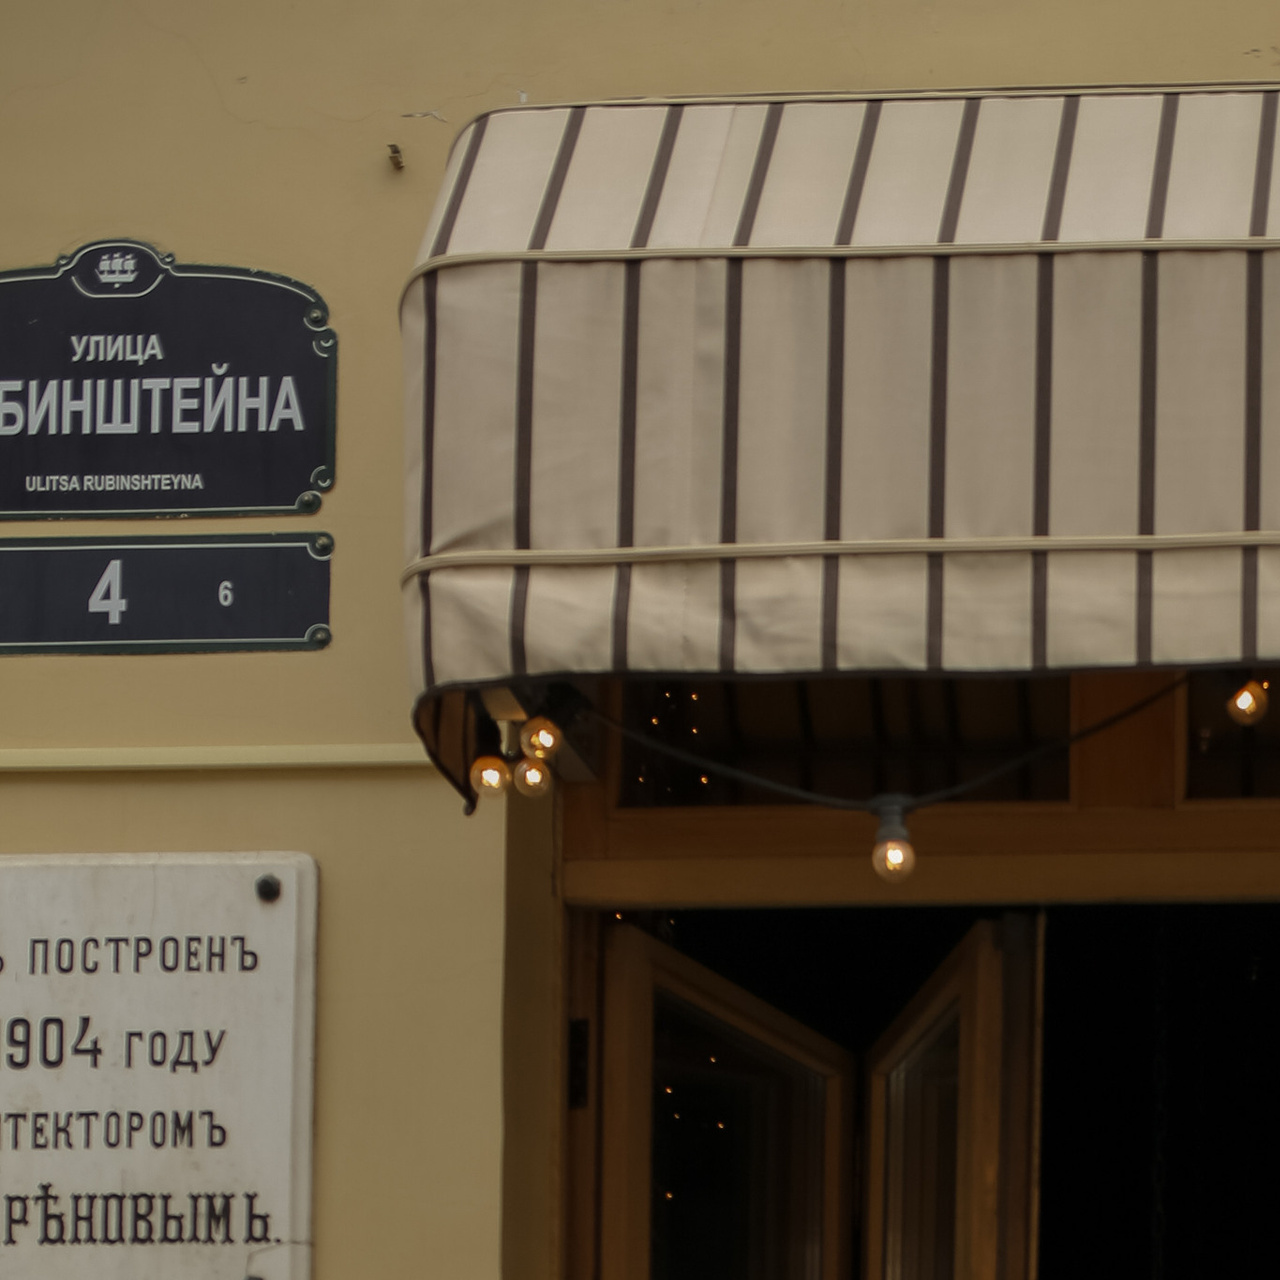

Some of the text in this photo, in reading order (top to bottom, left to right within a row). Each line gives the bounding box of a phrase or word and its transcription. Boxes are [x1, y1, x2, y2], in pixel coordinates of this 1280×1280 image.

[71, 334, 164, 366] УЛИЦА
[25, 473, 204, 492] ULITSA RUBINSHTEYNA
[88, 559, 234, 625] 4 6
[28, 935, 259, 975] ПОСТРОЕНЪ
